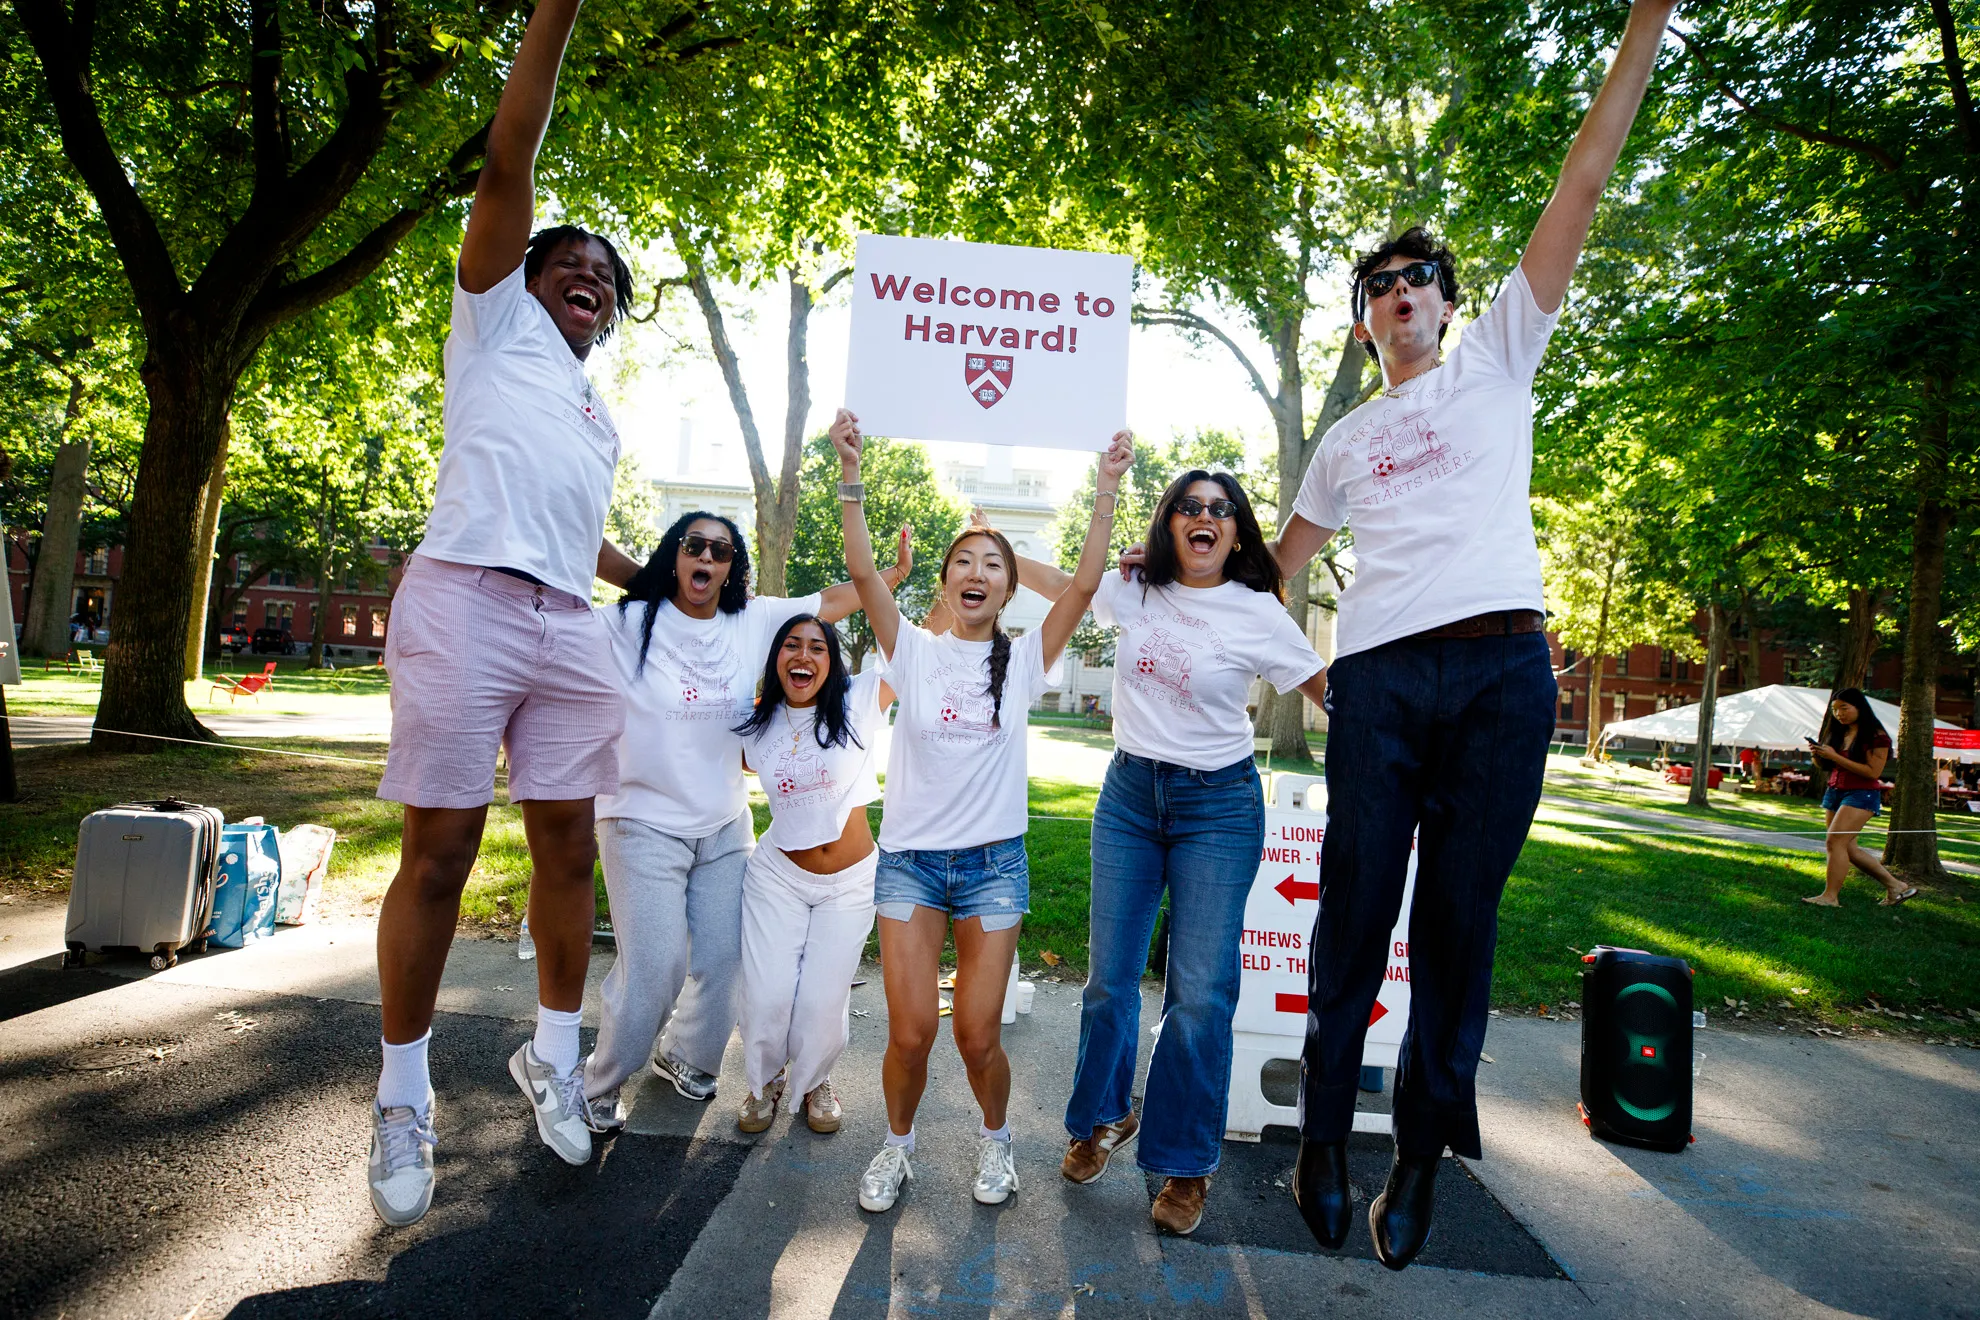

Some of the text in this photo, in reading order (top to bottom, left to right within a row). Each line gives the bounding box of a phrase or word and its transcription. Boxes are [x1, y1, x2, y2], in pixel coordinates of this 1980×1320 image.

[870, 272, 1115, 317] Welcome to
[904, 314, 1078, 353] Harvard!
[1363, 450, 1475, 507] STARTS HERE
[1129, 612, 1227, 667] EVERY GREAT STORY
[1161, 653, 1180, 672] 30
[1121, 675, 1167, 701] STARTS
[665, 710, 712, 721] STARTS
[921, 729, 972, 745] STARTS
[760, 736, 785, 765] EVERY
[797, 762, 814, 778] 30
[775, 795, 815, 812] STARTS
[1241, 929, 1302, 950] TTHEWS
[1242, 953, 1271, 971] ELD
[1286, 957, 1309, 975] TH
